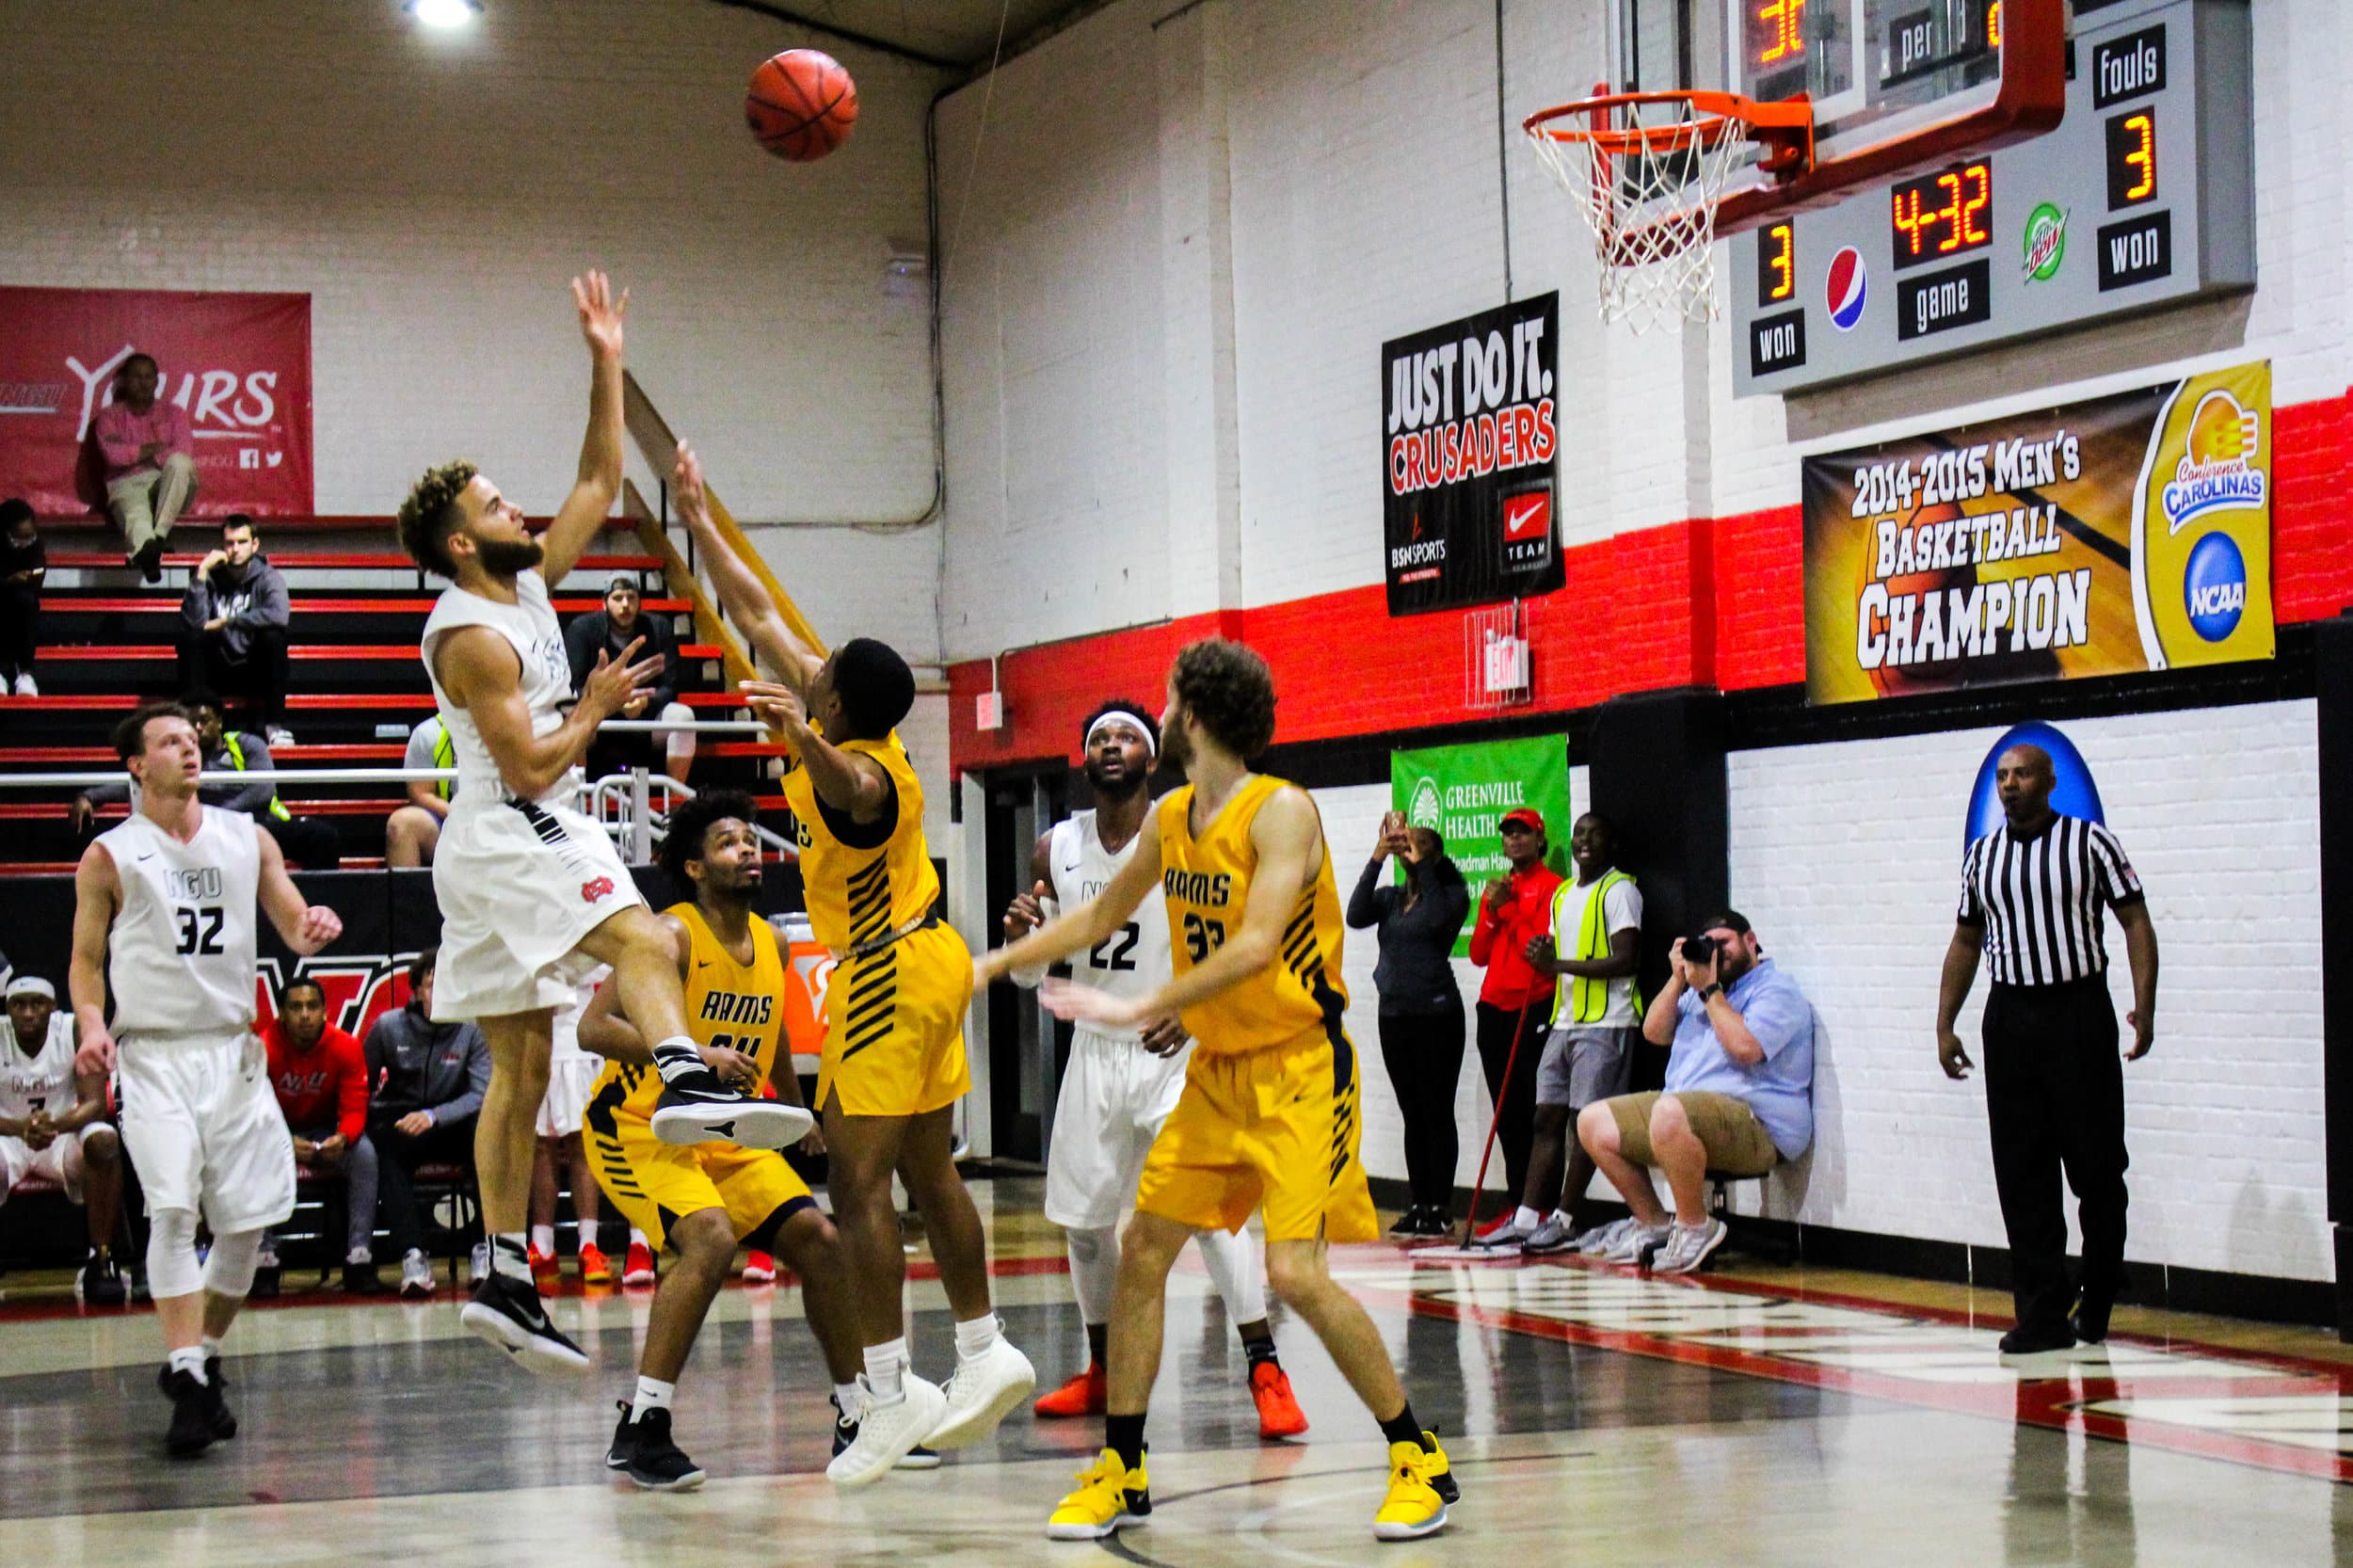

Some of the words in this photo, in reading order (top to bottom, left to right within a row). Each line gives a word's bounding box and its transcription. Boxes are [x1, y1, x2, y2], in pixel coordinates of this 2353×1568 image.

[2101, 39, 2156, 98] fouls
[2124, 114, 2153, 200] 3
[1769, 224, 1791, 299] 3
[2110, 227, 2158, 275] won
[1916, 278, 1969, 333] game
[1759, 322, 1796, 363] won
[1389, 342, 1457, 435] JUST
[1463, 330, 1507, 417] DO
[1512, 316, 1553, 403] IT.
[1388, 397, 1556, 496] CRUSADERS
[1851, 443, 1989, 519] 2014-2015
[2179, 458, 2245, 485] Conference
[2165, 475, 2263, 516] CAROLINAS
[1508, 542, 1545, 560] TEAM
[2190, 582, 2246, 618] NCAA
[1446, 780, 1526, 809] GREENVILLE
[1446, 814, 1497, 840] HEALTH
[164, 867, 222, 900] NGU
[176, 906, 224, 955] 32
[699, 990, 774, 1025] RAMS
